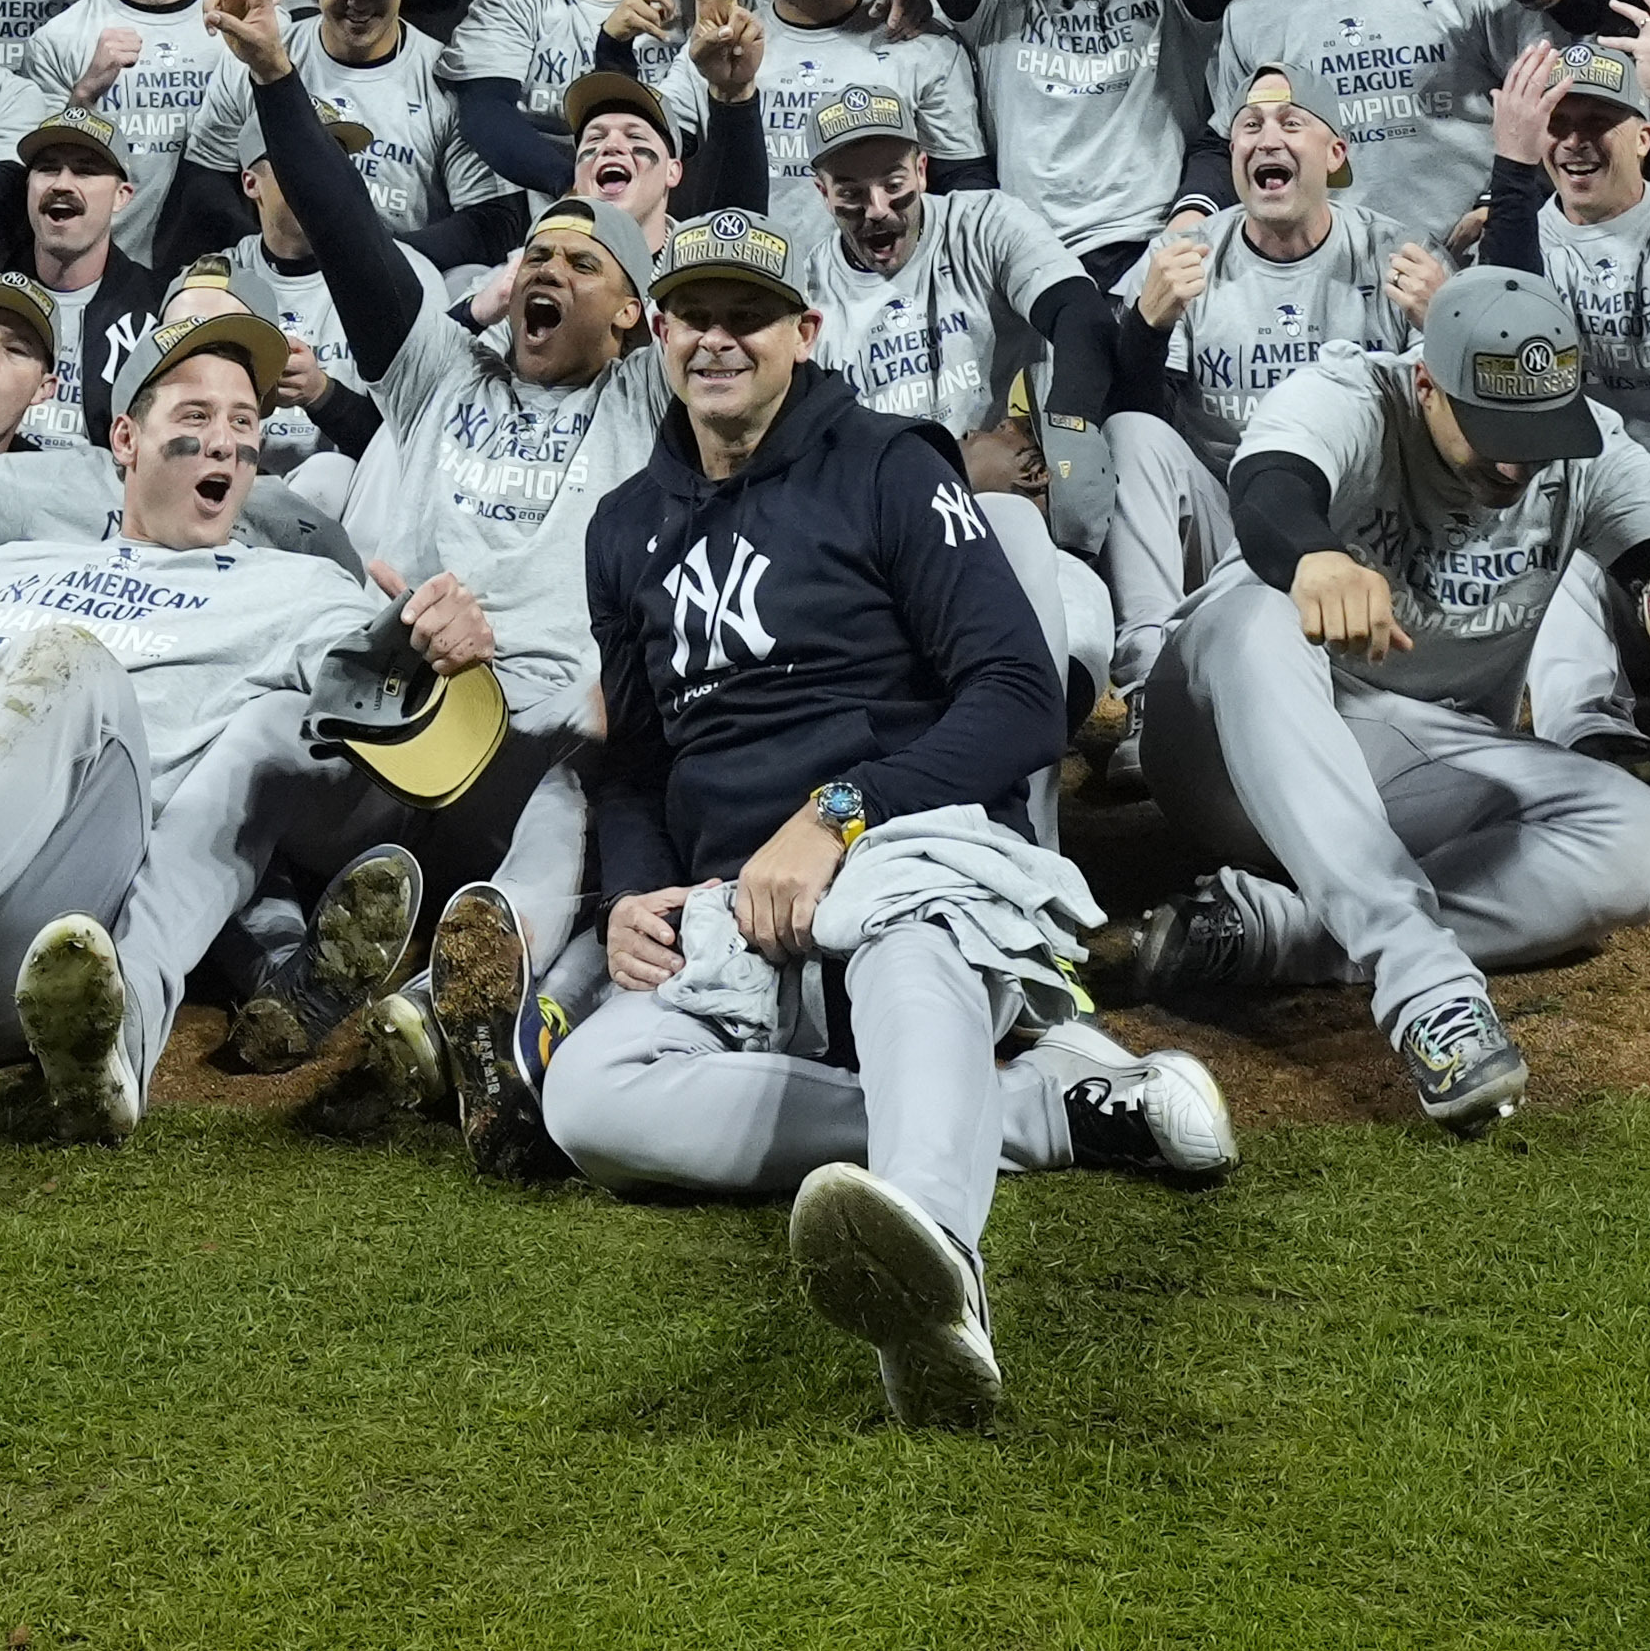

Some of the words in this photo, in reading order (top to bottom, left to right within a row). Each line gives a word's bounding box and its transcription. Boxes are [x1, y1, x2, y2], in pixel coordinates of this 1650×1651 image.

[1058, 25, 1133, 56] LEAGUE
[1016, 44, 1160, 85] CHAMPIONS
[1320, 43, 1446, 77] AMERICAN
[1069, 81, 1105, 96] ALCS
[1334, 70, 1414, 96] EAGUE
[137, 89, 204, 109] LEAGU
[1340, 90, 1454, 129] MPIONS
[821, 115, 860, 143] WORLD
[862, 107, 901, 127] SERIES
[1349, 127, 1386, 145] ALCS
[1387, 125, 1418, 138] 2024
[782, 164, 816, 179] ALCS
[751, 231, 763, 242] 24
[675, 241, 725, 268] WORLD
[732, 242, 782, 272] SERIES
[1476, 374, 1538, 398] WORLD
[476, 503, 516, 523] ALCS
[55, 570, 211, 610] AMERICAN
